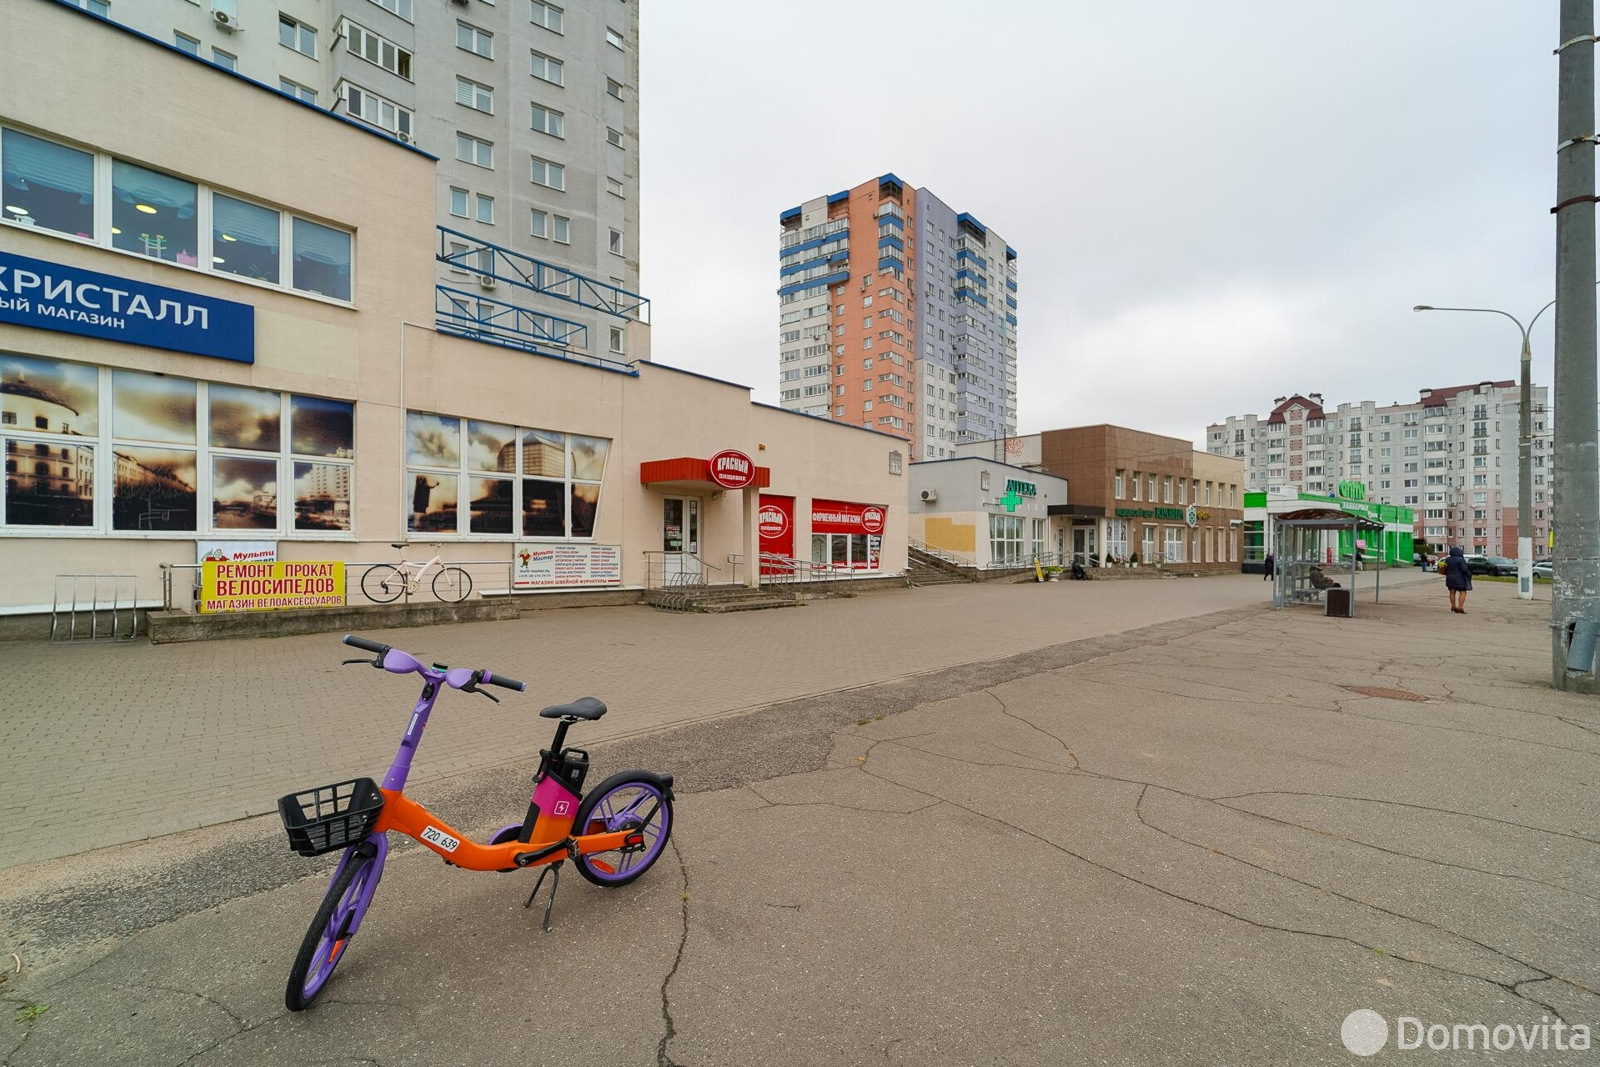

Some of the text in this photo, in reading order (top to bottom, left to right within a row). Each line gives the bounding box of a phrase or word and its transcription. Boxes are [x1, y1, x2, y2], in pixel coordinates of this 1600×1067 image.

[38, 304, 125, 329] МАГАЗИН
[717, 457, 749, 474] КРАСНЫЙ
[1006, 479, 1037, 497] АПТЕКА
[233, 550, 274, 561] Мульти
[217, 564, 334, 578] РЕМОНТ ПРОКАТ
[216, 578, 334, 596] ВЕЛОСИПЕДОВ
[207, 599, 254, 610] МАГАЗИН
[258, 595, 342, 608] ВЕЛОАКСЕССУАРОВ
[424, 828, 457, 849] 720 639
